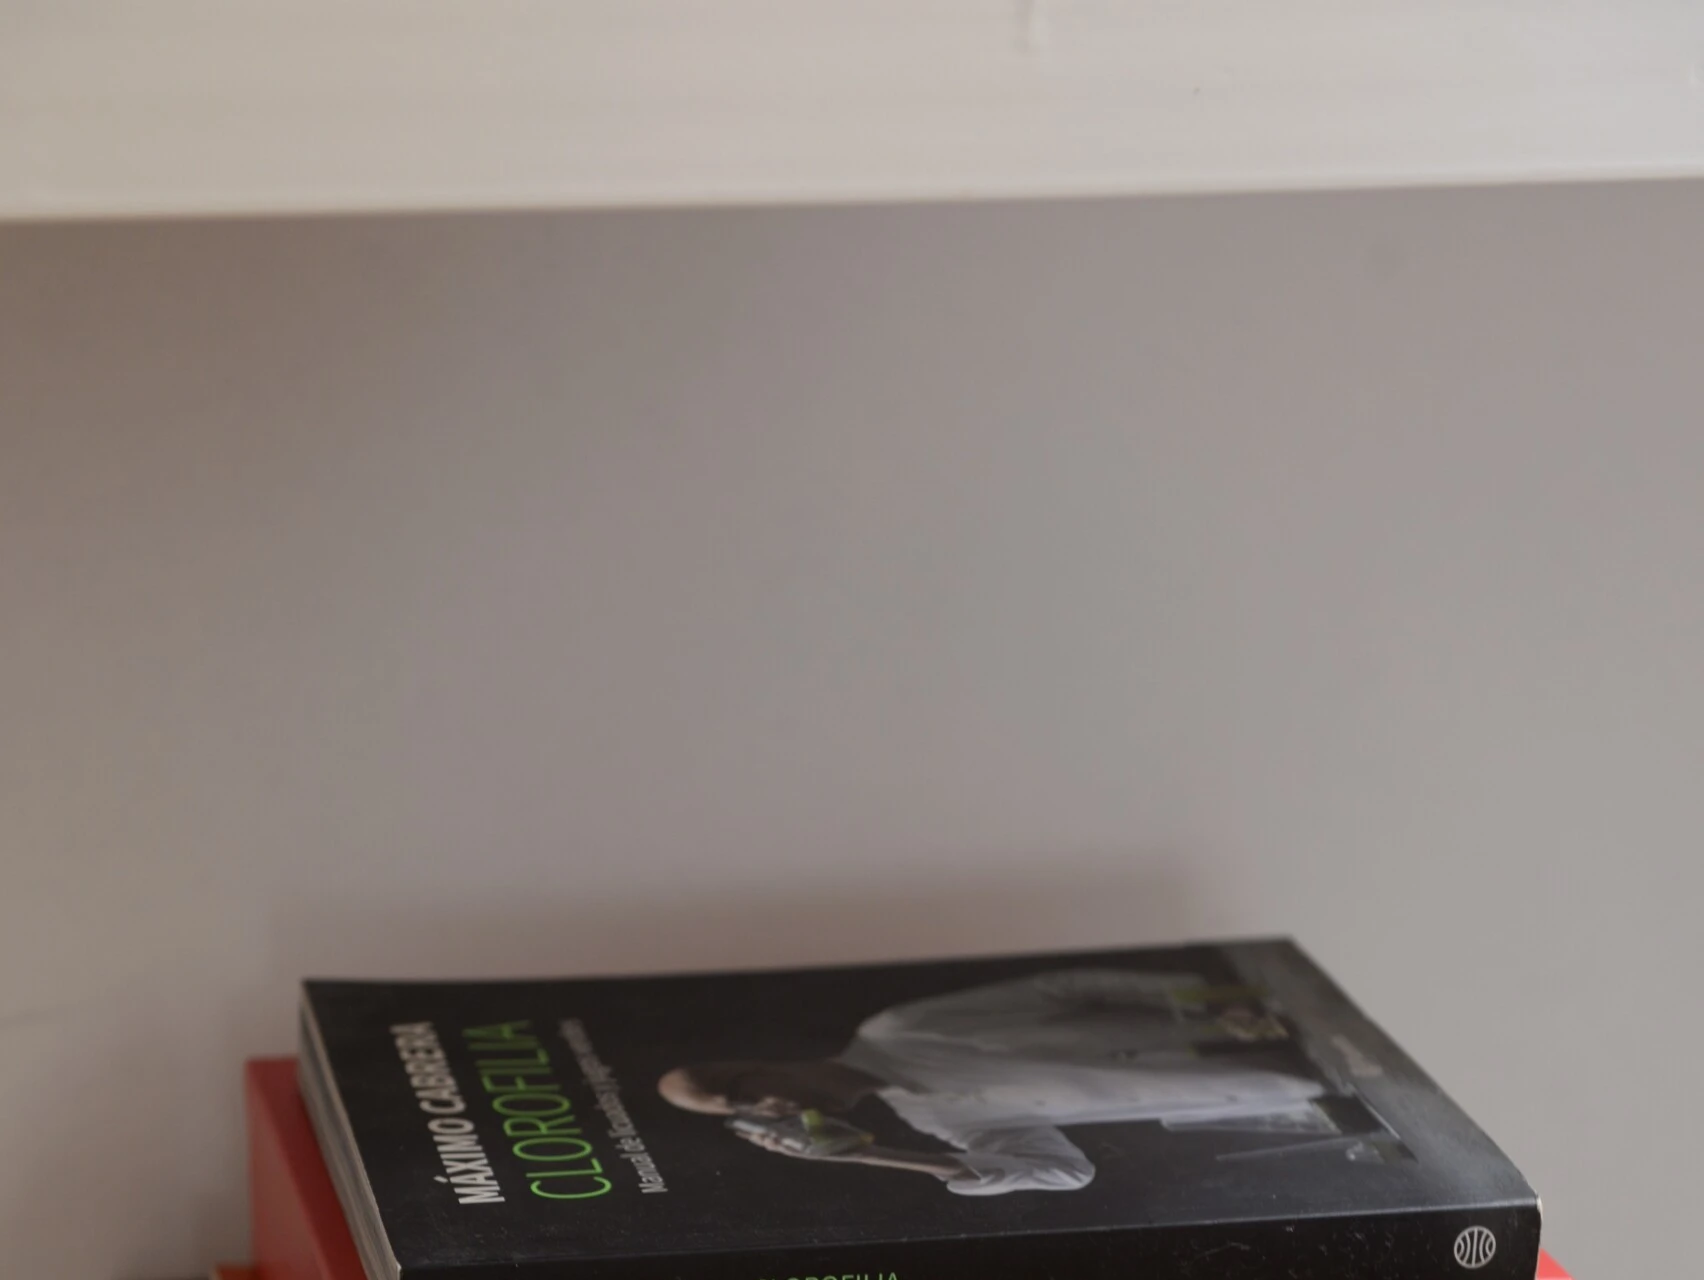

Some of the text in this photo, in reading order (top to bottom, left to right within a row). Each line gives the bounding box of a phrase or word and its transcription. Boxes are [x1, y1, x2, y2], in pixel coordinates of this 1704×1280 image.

[389, 1020, 505, 1204] MÁXIMO CABRERA
[462, 1020, 612, 1199] CLOROFILIA
[619, 1152, 668, 1193] Manual
